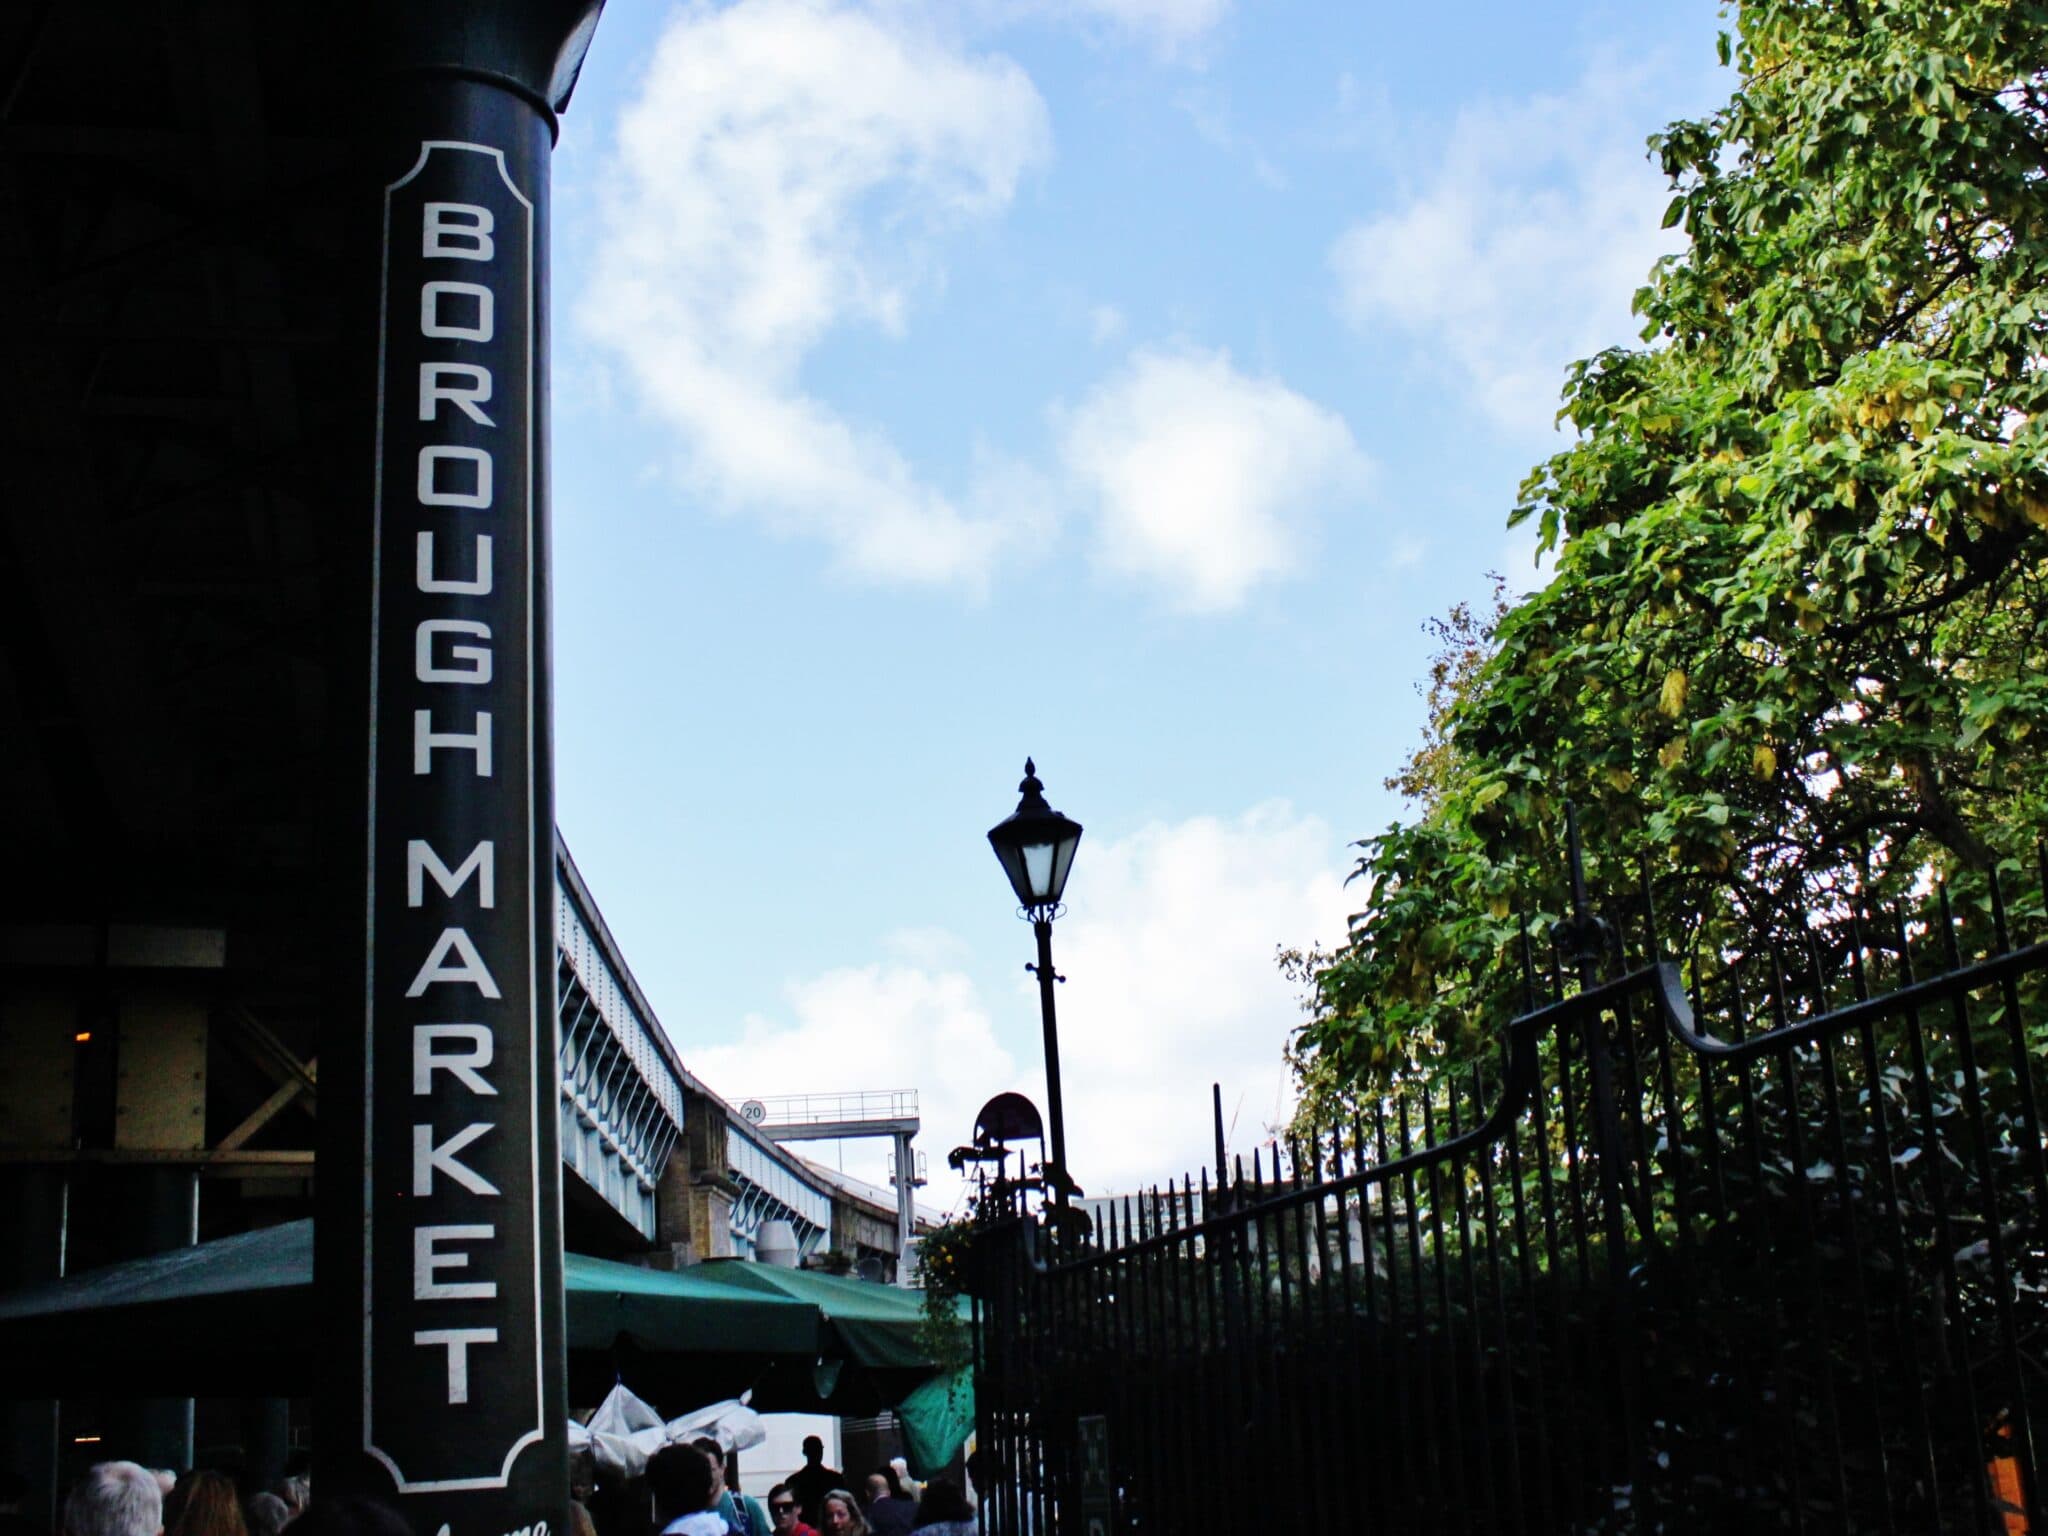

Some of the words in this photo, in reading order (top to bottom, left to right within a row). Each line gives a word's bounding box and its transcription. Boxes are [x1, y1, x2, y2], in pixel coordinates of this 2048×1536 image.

[413, 202, 496, 778] BOROUGH
[405, 839, 502, 1405] MARKET
[745, 1106, 761, 1119] 20
